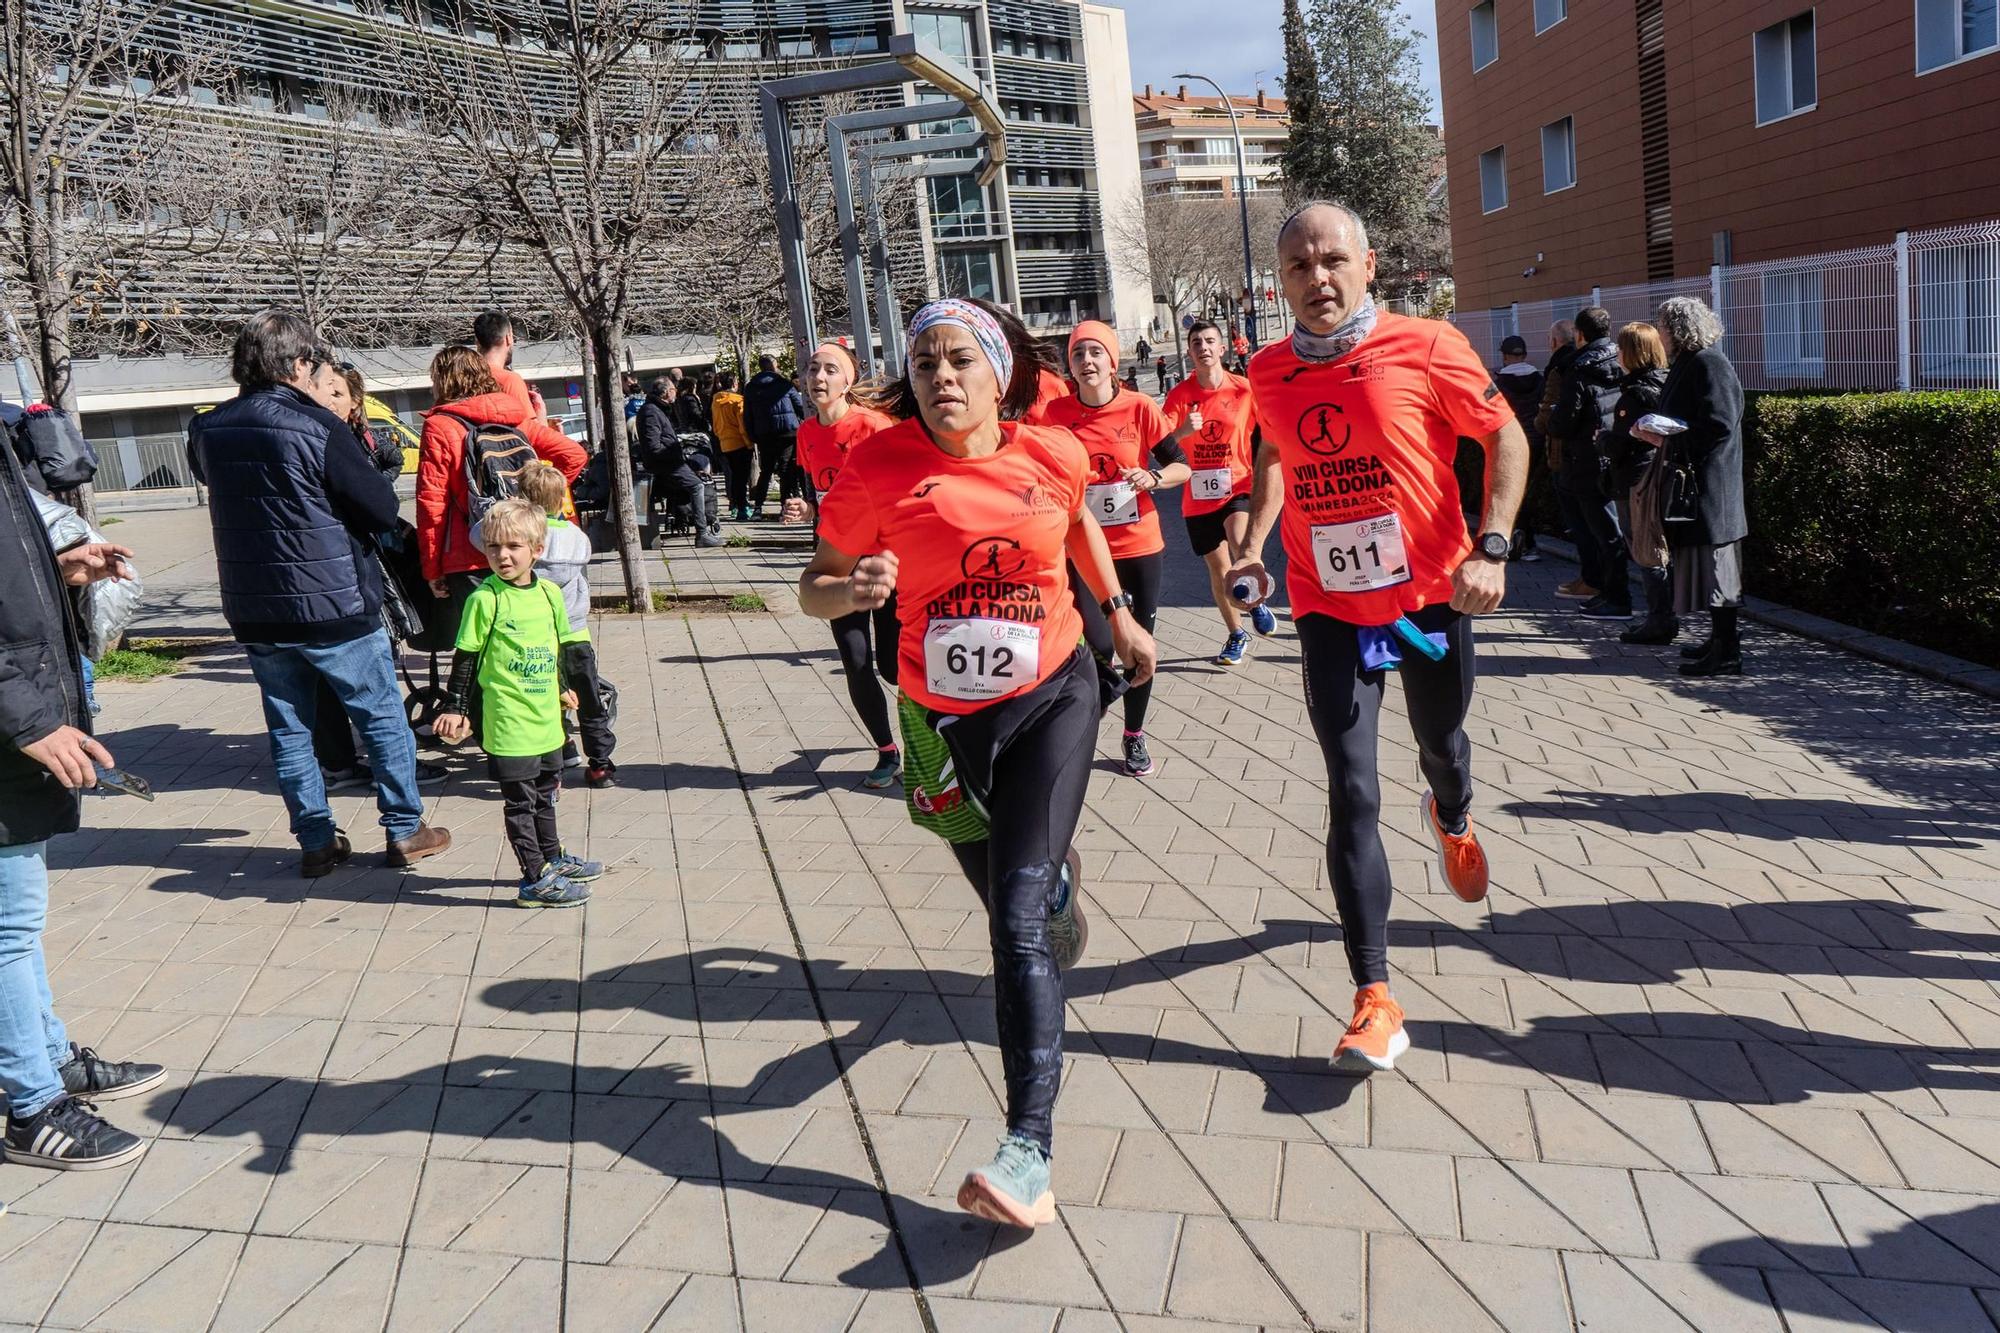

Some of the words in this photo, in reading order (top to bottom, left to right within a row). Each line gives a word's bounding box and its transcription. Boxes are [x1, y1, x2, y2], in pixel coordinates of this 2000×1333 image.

[1293, 464, 1317, 482] VIII
[1320, 455, 1383, 478] CURSA
[1203, 479, 1219, 491] 16
[1294, 482, 1315, 500] DE
[1315, 479, 1337, 497] LA
[1338, 470, 1393, 494] DONA
[1103, 497, 1115, 514] 5
[1329, 541, 1381, 572] 611
[971, 581, 1041, 602] CURSA
[926, 602, 953, 618] DE
[956, 601, 982, 619] LA
[987, 602, 1046, 622] DONA
[946, 643, 1014, 678] 612
